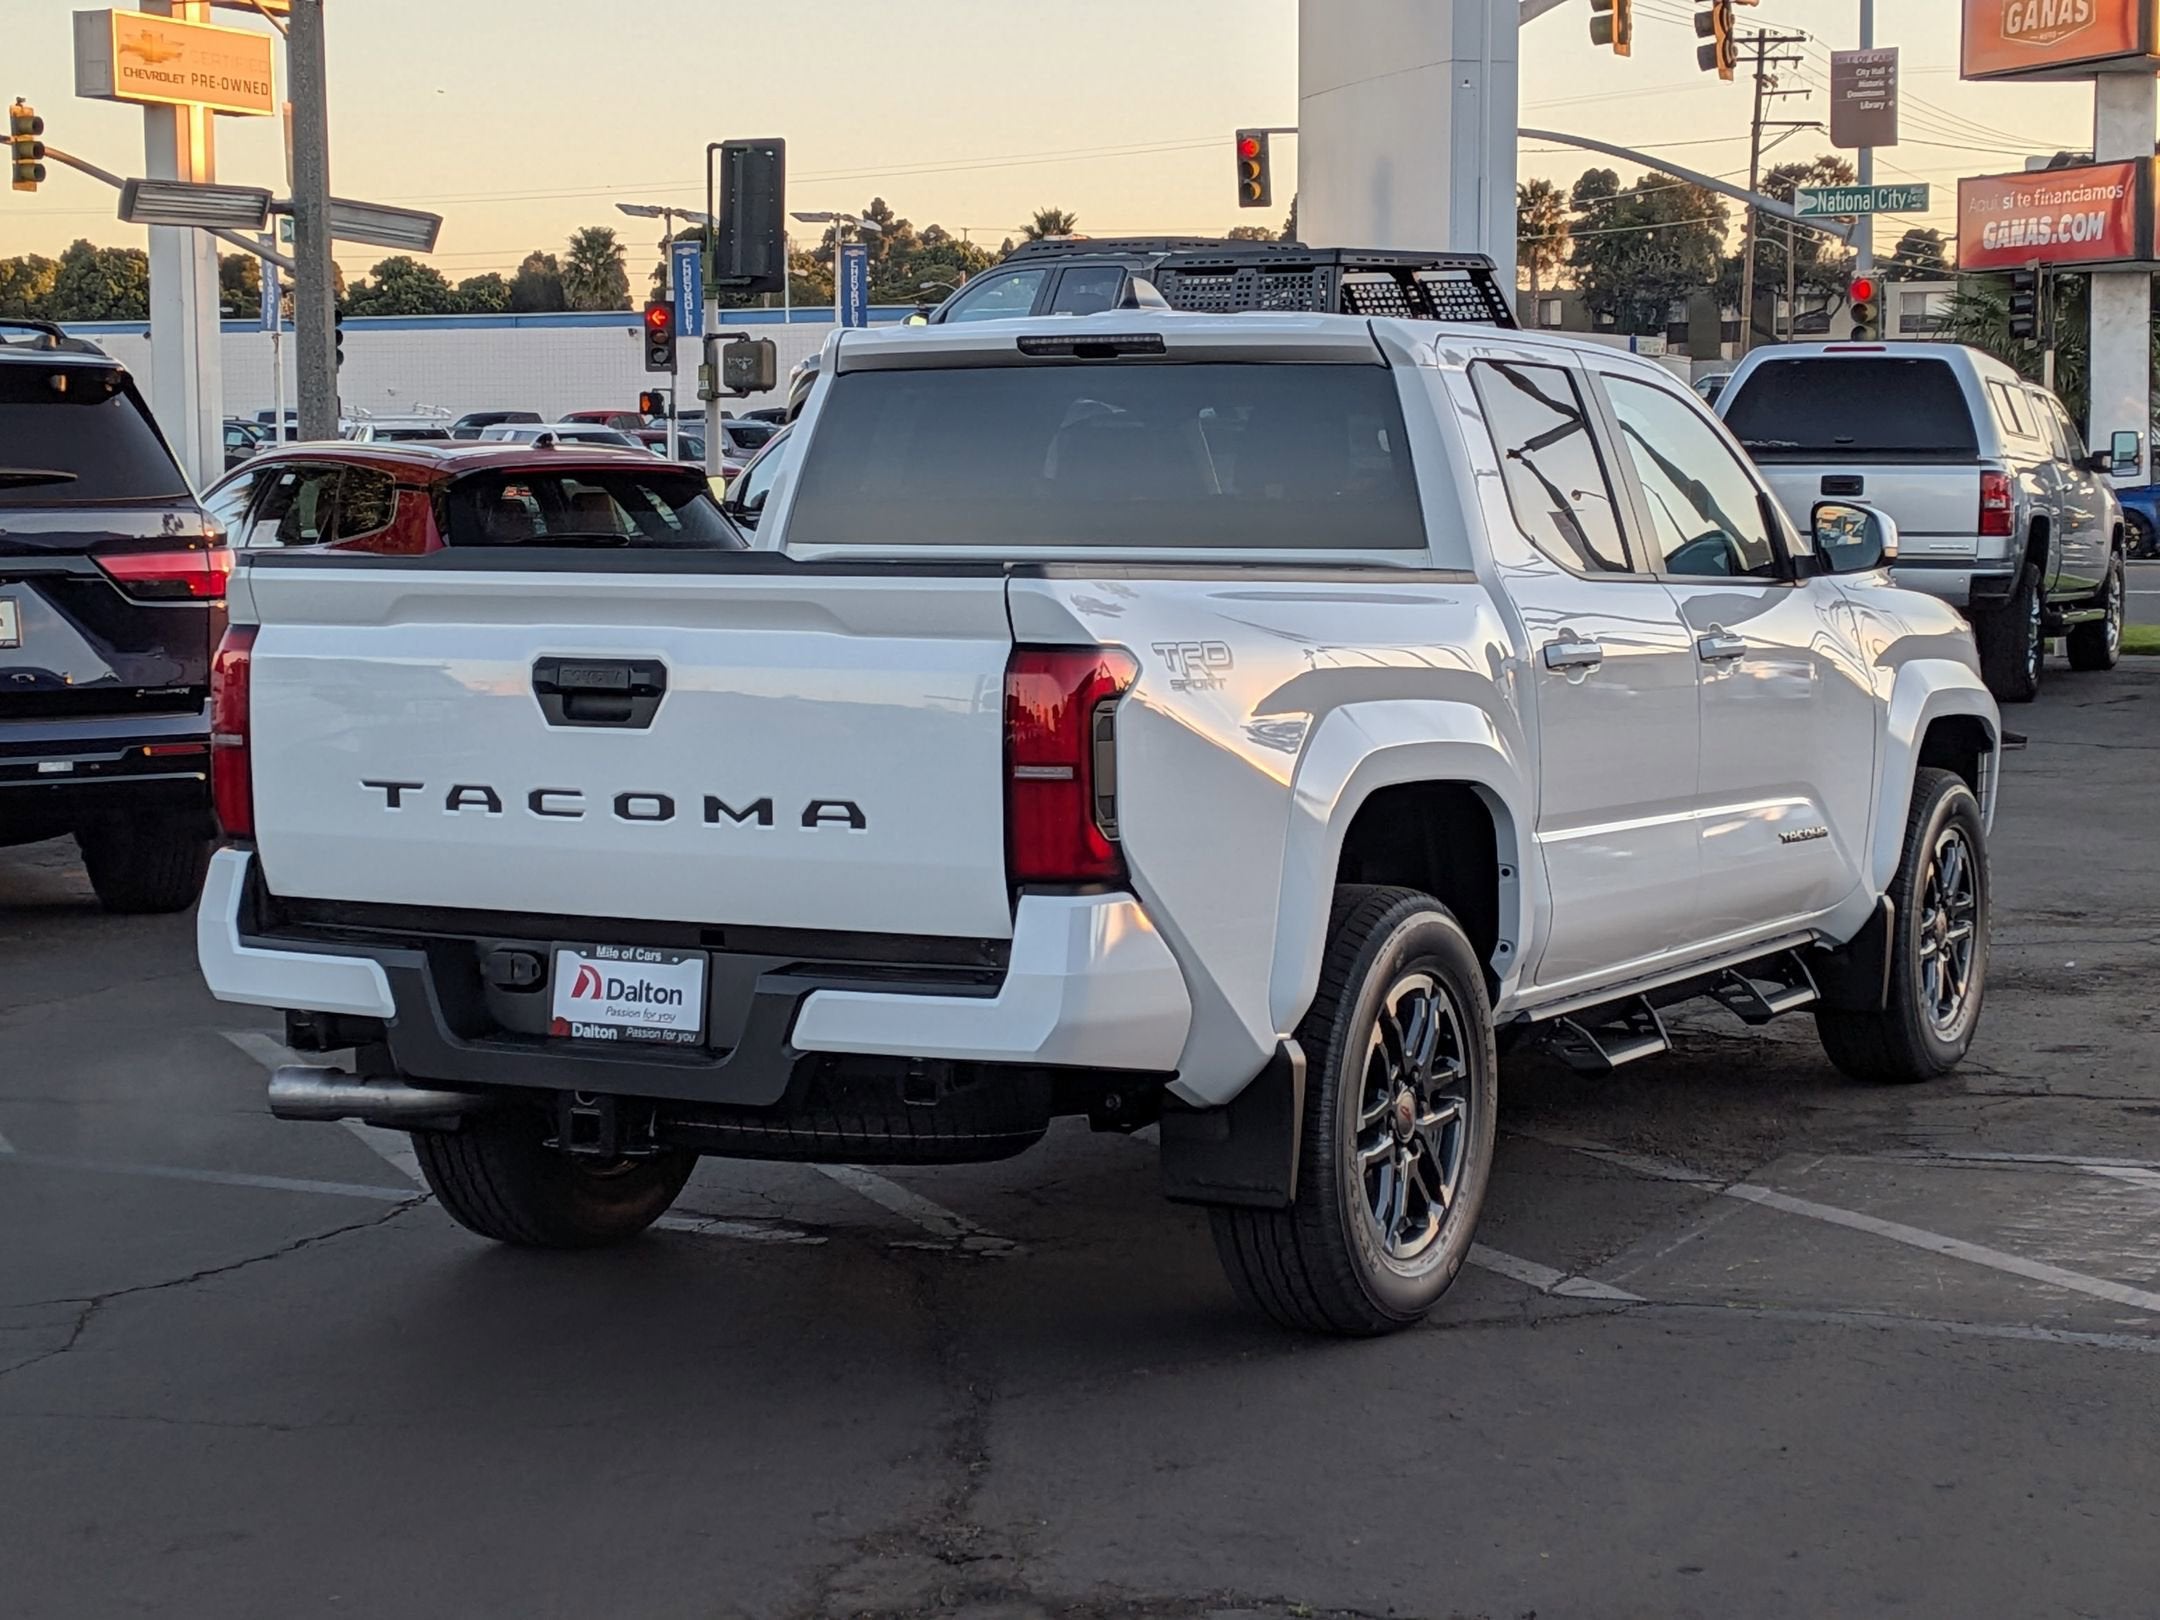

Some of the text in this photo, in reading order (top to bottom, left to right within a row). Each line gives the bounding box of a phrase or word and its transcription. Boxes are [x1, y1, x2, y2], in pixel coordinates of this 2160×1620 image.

[2006, 0, 2089, 34] GANAS
[123, 67, 269, 96] CHEVROLET PRE-OWNED
[1856, 68, 1870, 77] City
[1860, 101, 1885, 110] Library
[1817, 188, 1907, 212] National City
[2002, 192, 2015, 209] sí
[2017, 193, 2031, 208] te
[2034, 184, 2124, 206] financiamos
[1983, 211, 2106, 250] GANAS.COM
[682, 258, 693, 335] CHEVROLET
[1151, 641, 1233, 680] TRD
[1170, 678, 1227, 692] SPORT
[361, 779, 867, 831] TACOMA
[596, 945, 661, 961] Mile of Cars
[606, 978, 682, 1005] Dalton
[605, 1006, 676, 1022] Passion for you
[571, 1023, 696, 1043] Dalton Passion for you
